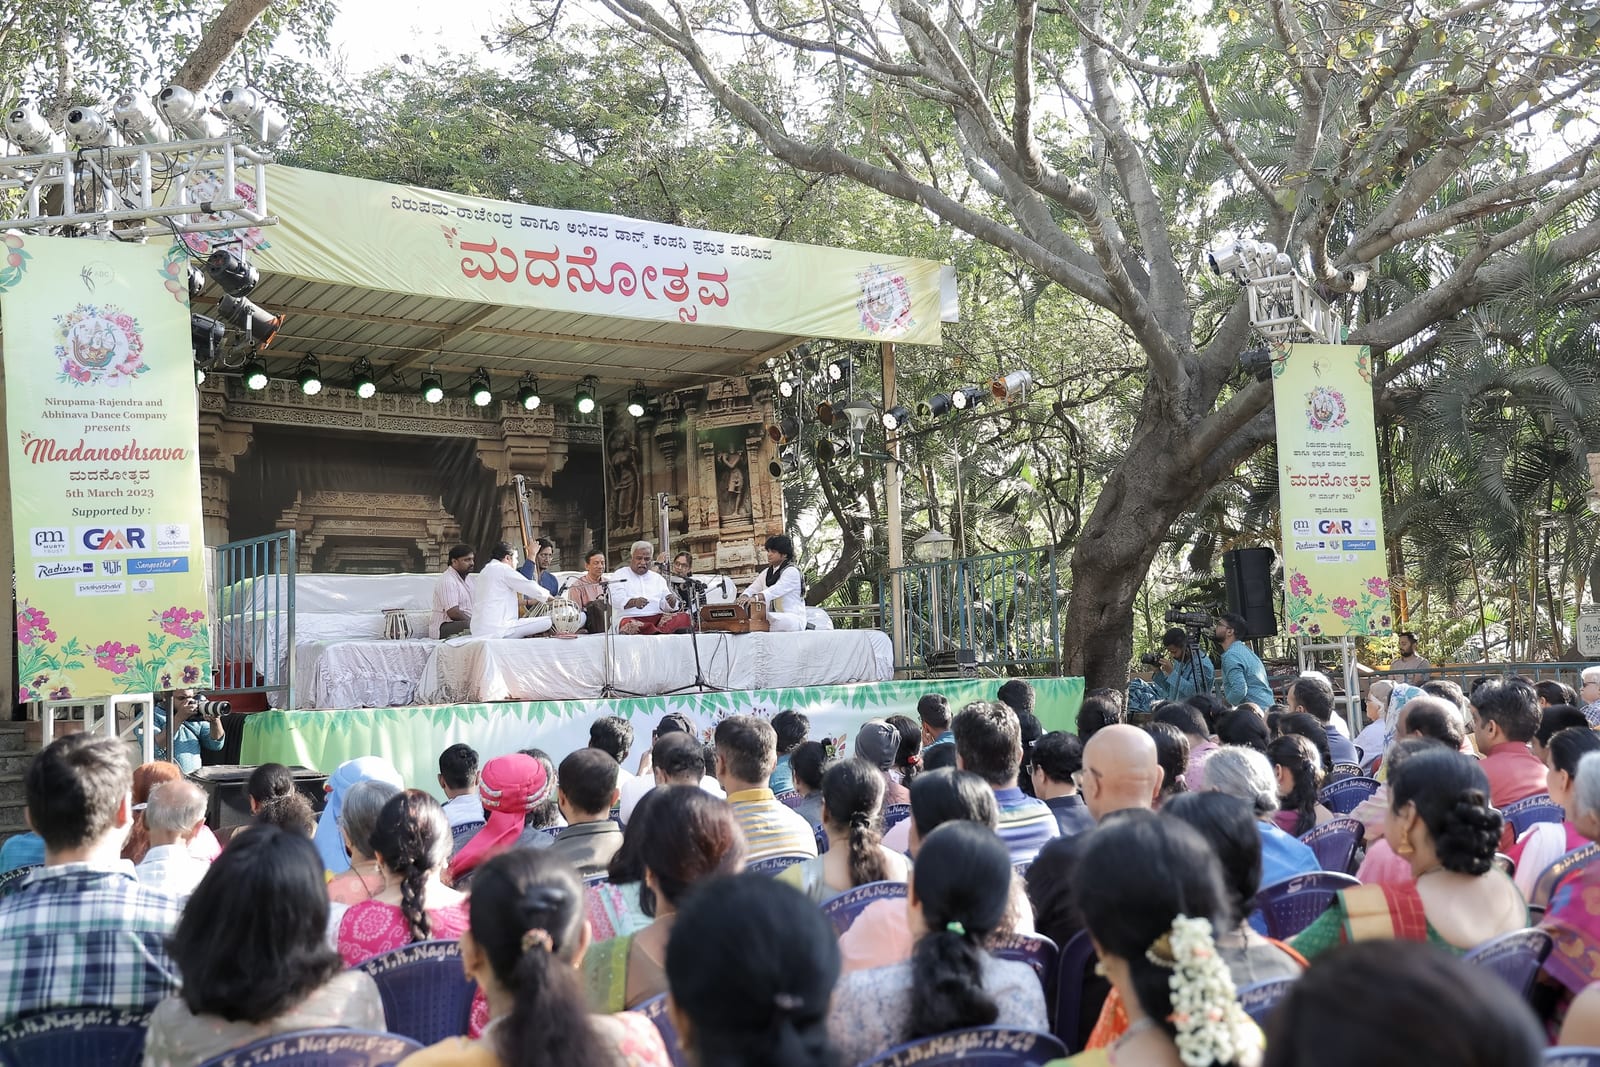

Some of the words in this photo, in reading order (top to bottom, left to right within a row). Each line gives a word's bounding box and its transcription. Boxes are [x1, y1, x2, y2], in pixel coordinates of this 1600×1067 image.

[520, 215, 560, 232] ಹಾಗೂ
[567, 222, 608, 239] ಅಭಿನವ
[615, 230, 648, 249] ಡಾನ್ಸ್
[653, 234, 687, 249] ಕಂಪನಿ
[693, 240, 724, 256] ಪ್ರಸ್ತುತ
[731, 245, 772, 261] ಪಡಿಸುವ
[460, 237, 729, 323] ಮದನೋತ್ಸವ
[45, 397, 143, 408] Nirupama-Rajendra
[145, 398, 163, 407] and
[41, 410, 88, 420] Abhinava
[91, 411, 121, 420] Dance
[122, 411, 168, 421] Company
[84, 424, 131, 434] presents
[24, 438, 188, 464] Madanothsava
[70, 468, 150, 485] ಮದನೋತ್ಸವ
[1290, 472, 1371, 493] ಮದನೋತ್ಸವ
[65, 488, 84, 498] 5th
[87, 488, 124, 498] March
[126, 488, 154, 499] 2023
[72, 507, 128, 518] Supported
[131, 506, 145, 516] by
[1318, 520, 1352, 534] GMR
[83, 528, 145, 550] GMR
[38, 565, 82, 578] Radisson
